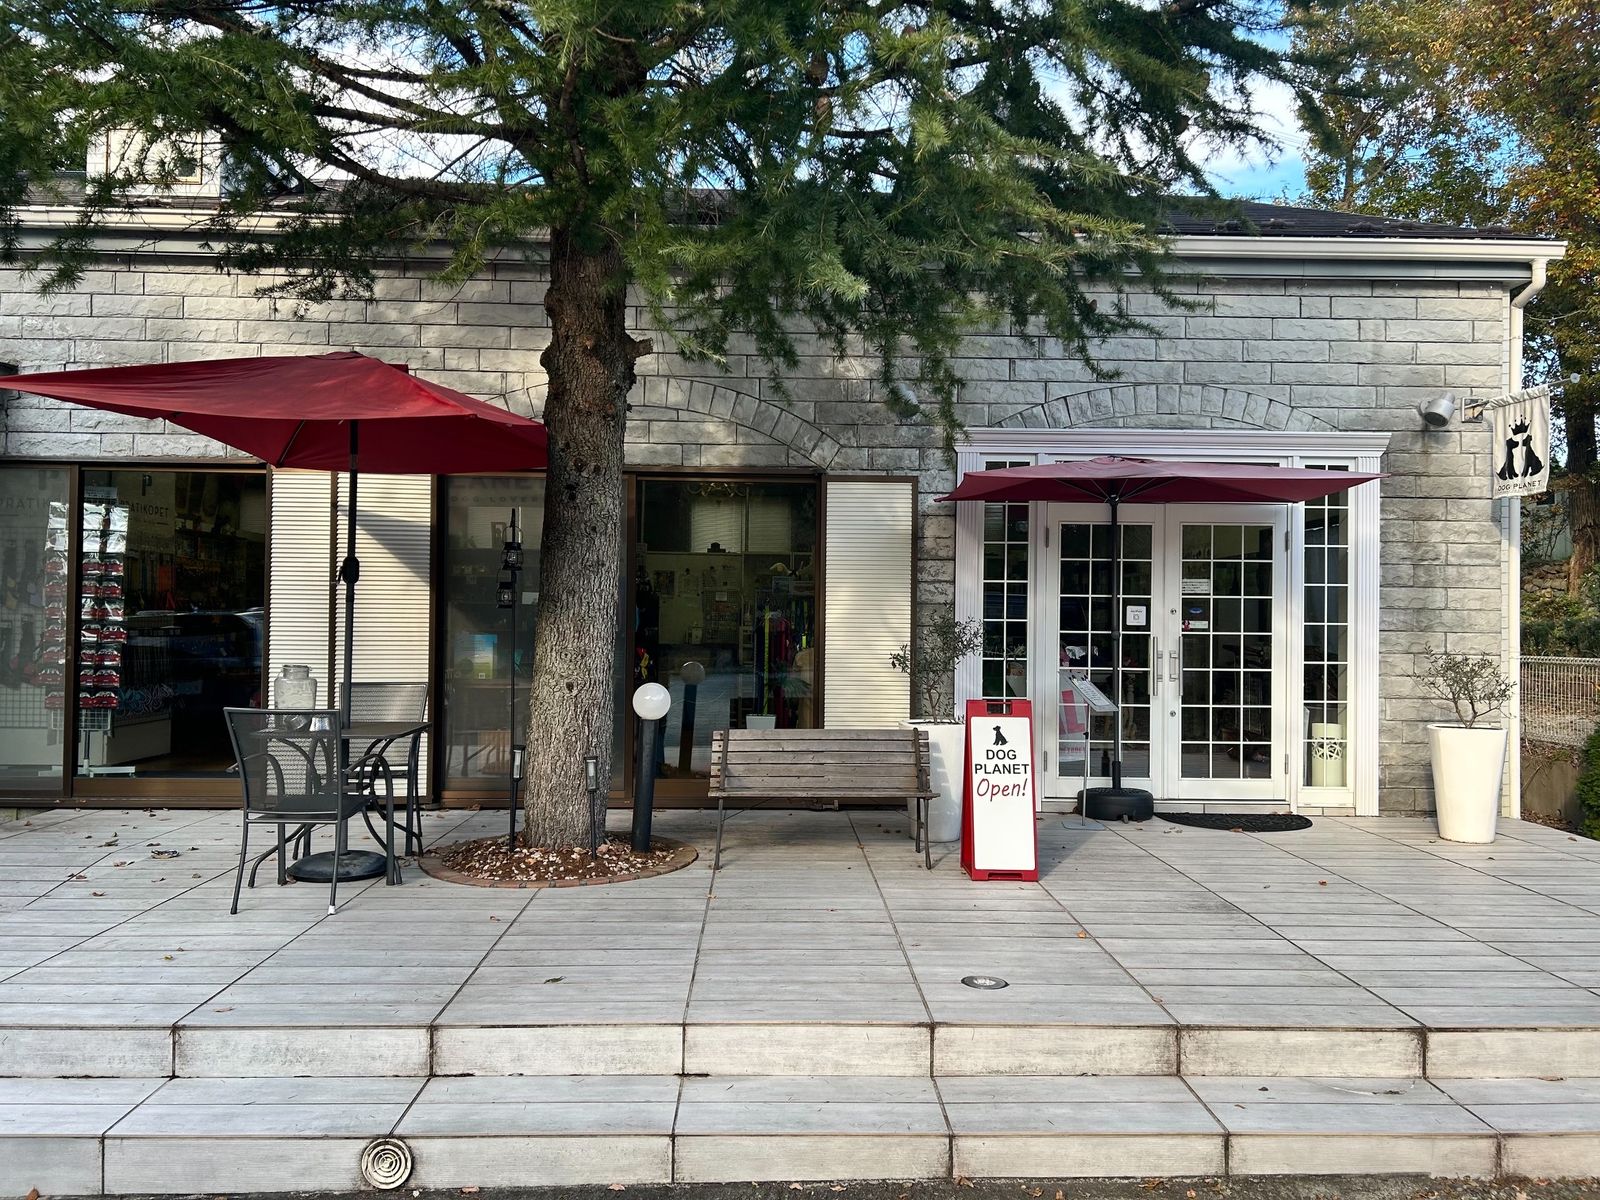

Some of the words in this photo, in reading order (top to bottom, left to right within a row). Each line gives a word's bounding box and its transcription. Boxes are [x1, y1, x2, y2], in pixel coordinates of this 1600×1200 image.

[1497, 483, 1511, 492] DOG
[1513, 480, 1542, 489] PLANET
[985, 749, 1017, 761] DOG
[974, 763, 1030, 775] PLANET
[976, 778, 1028, 802] Open!
